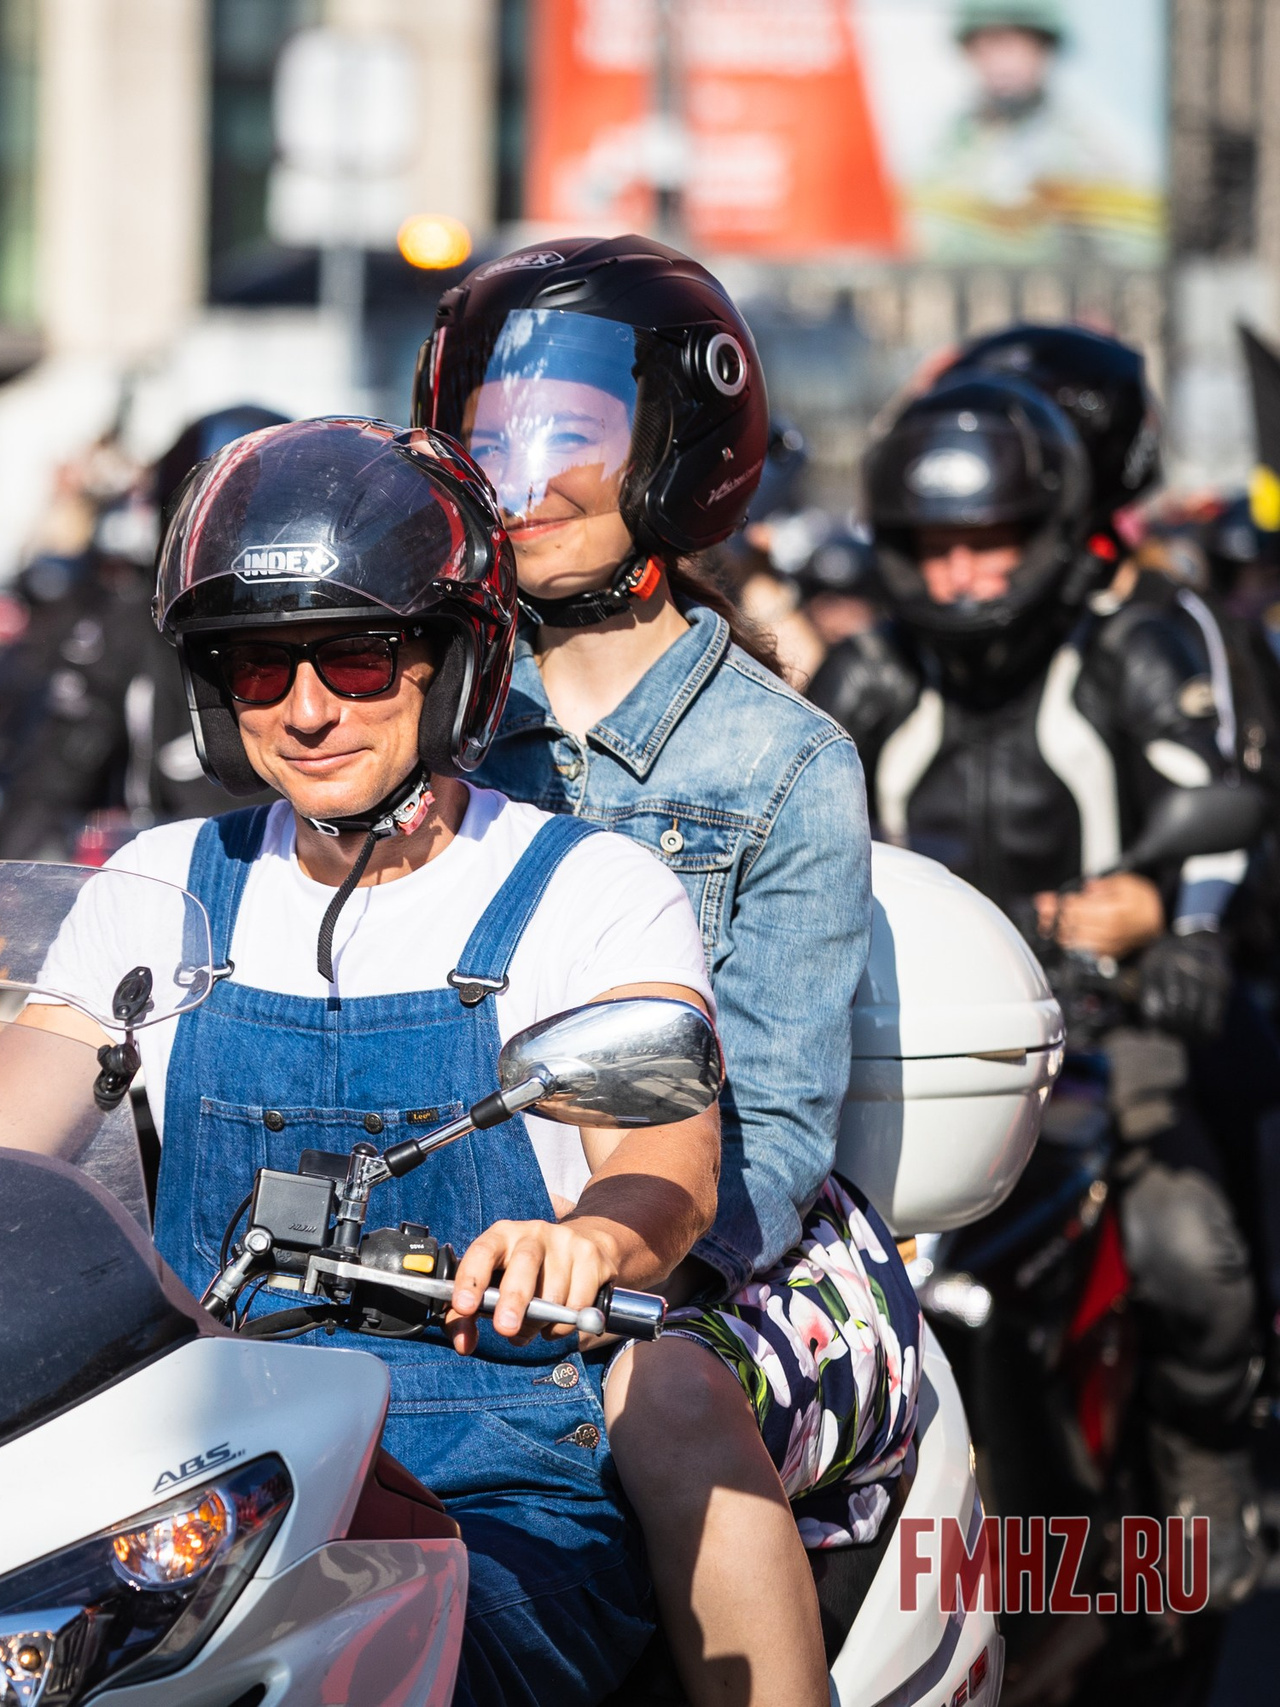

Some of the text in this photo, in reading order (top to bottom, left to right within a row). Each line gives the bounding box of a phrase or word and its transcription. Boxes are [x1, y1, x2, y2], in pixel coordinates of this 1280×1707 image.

[243, 550, 324, 577] INDEX
[554, 1366, 574, 1380] Lee
[152, 1441, 231, 1493] ABS
